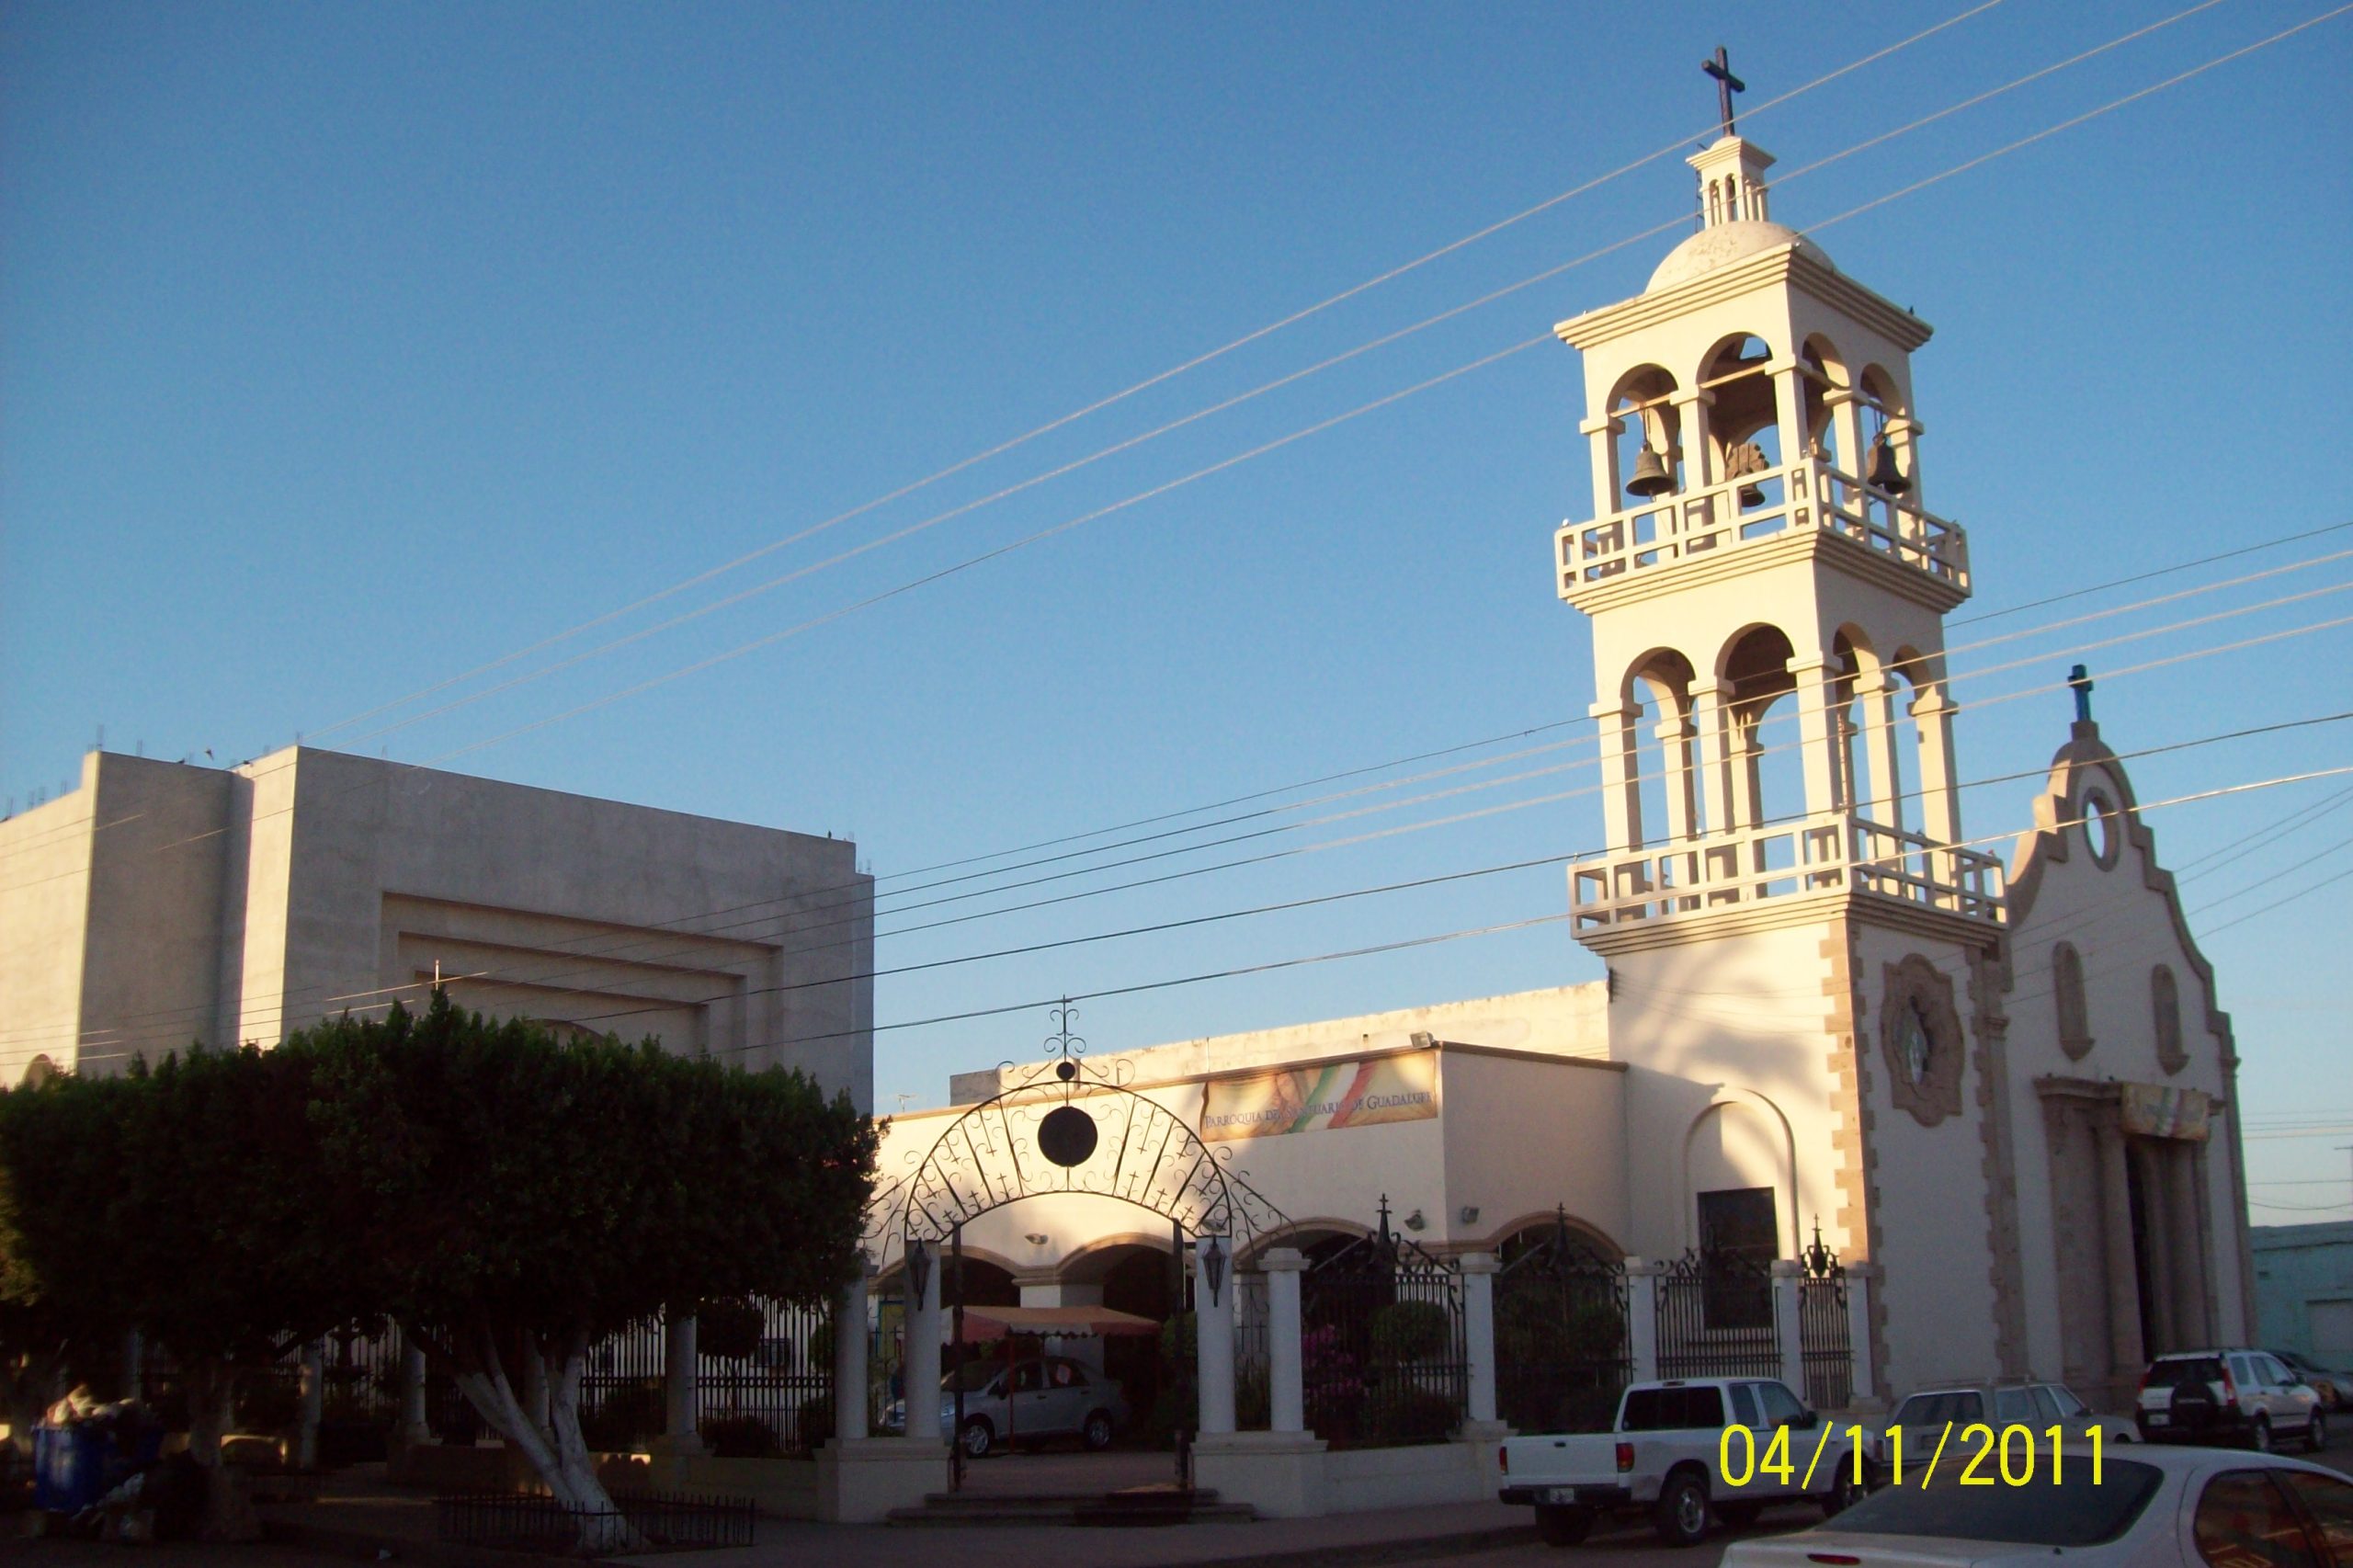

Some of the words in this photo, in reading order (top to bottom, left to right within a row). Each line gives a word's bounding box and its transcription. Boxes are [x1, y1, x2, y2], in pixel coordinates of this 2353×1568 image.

[1205, 1112, 1262, 1129] PARROQUIA
[1351, 1098, 1363, 1111] DE
[1367, 1091, 1433, 1110] GUADALUPE
